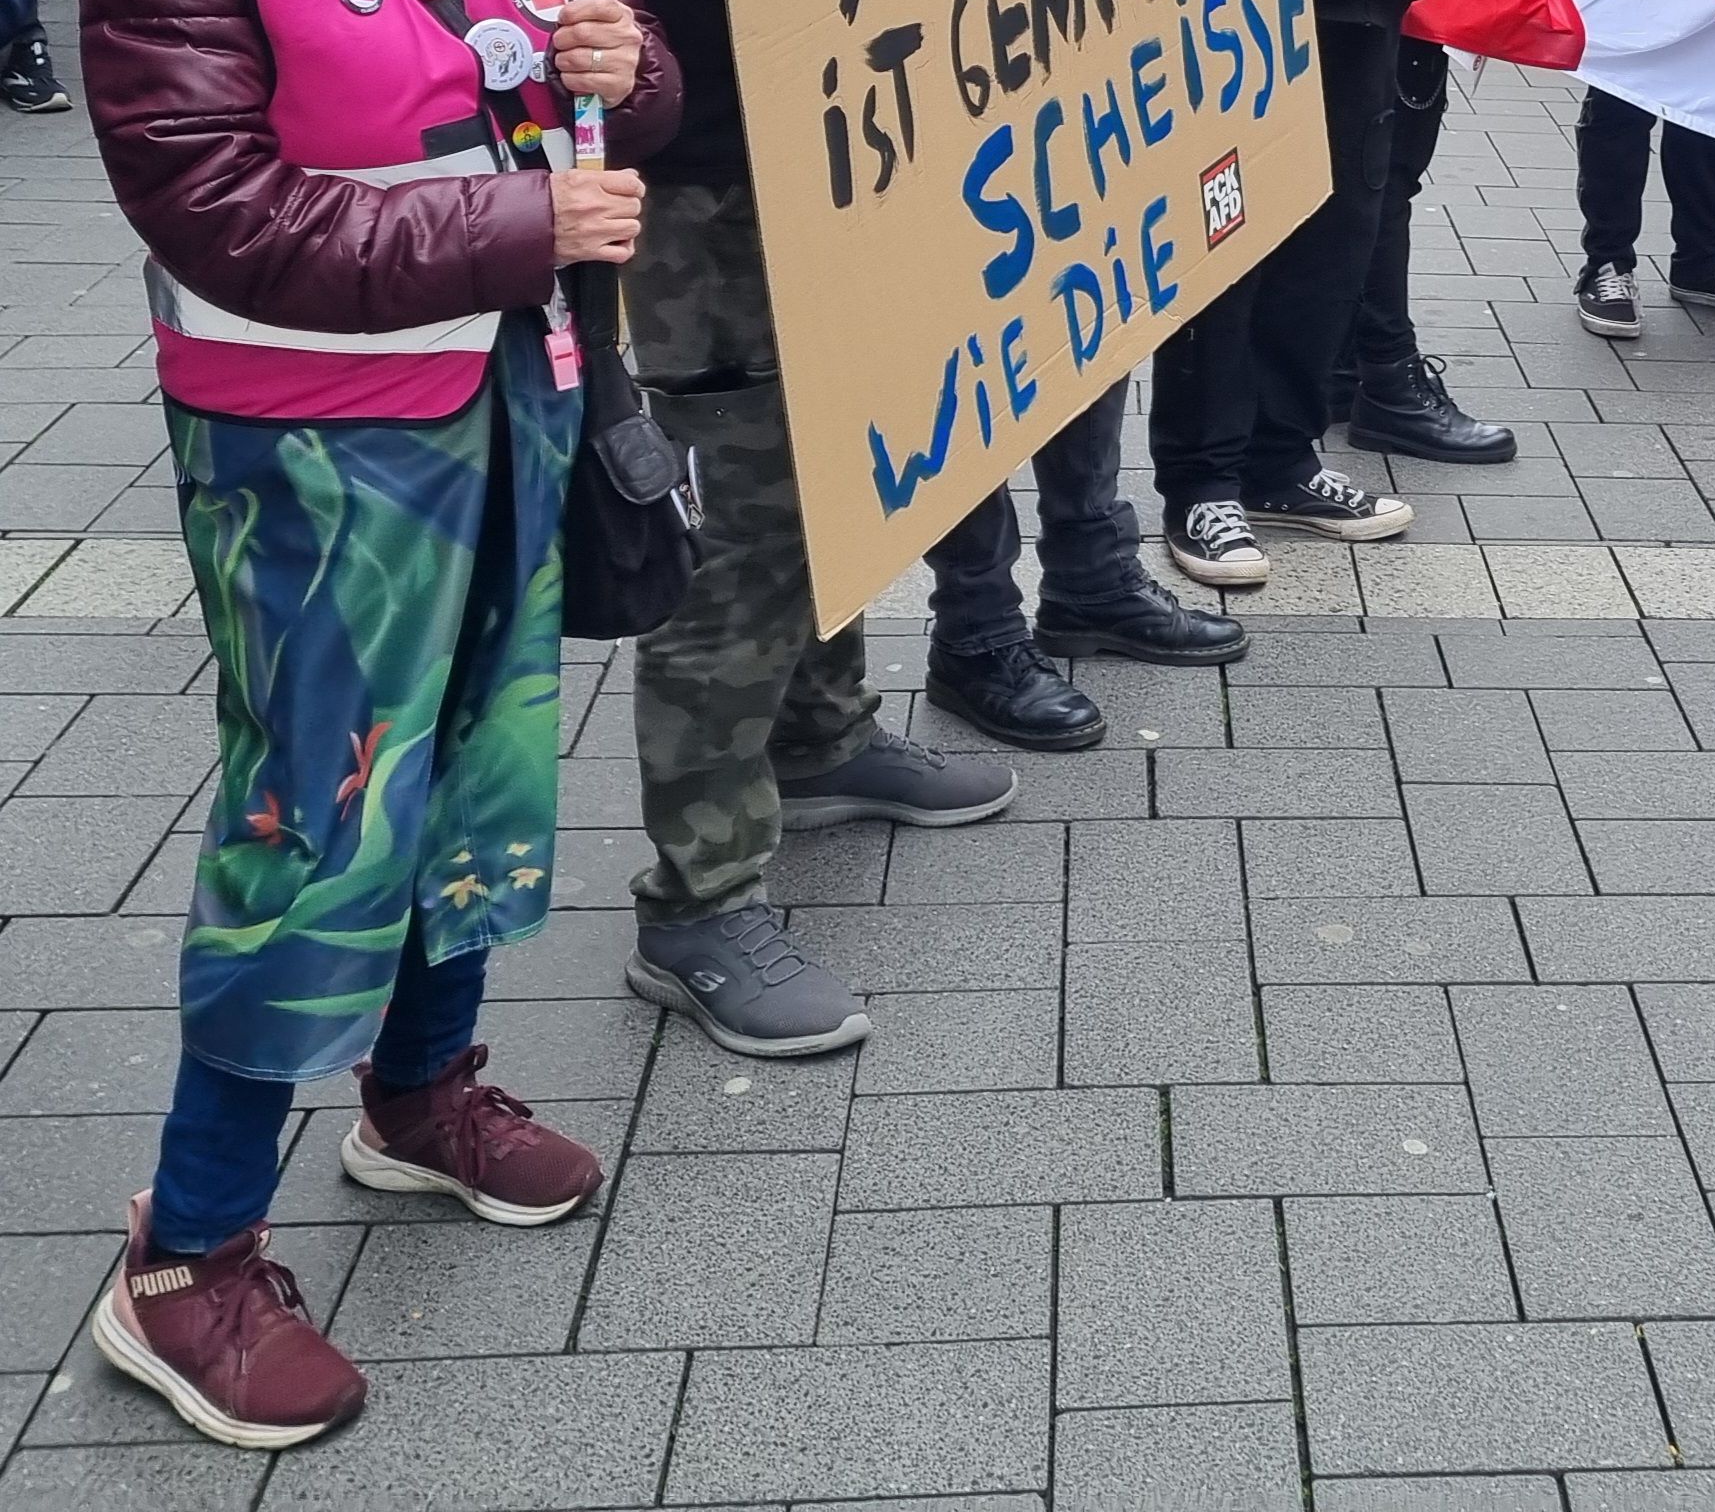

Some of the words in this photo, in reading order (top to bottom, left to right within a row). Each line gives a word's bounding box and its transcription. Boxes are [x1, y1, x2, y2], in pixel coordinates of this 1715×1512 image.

[1203, 162, 1239, 211] FCK
[1208, 189, 1242, 237] AFD
[131, 1265, 195, 1301] PUMA
